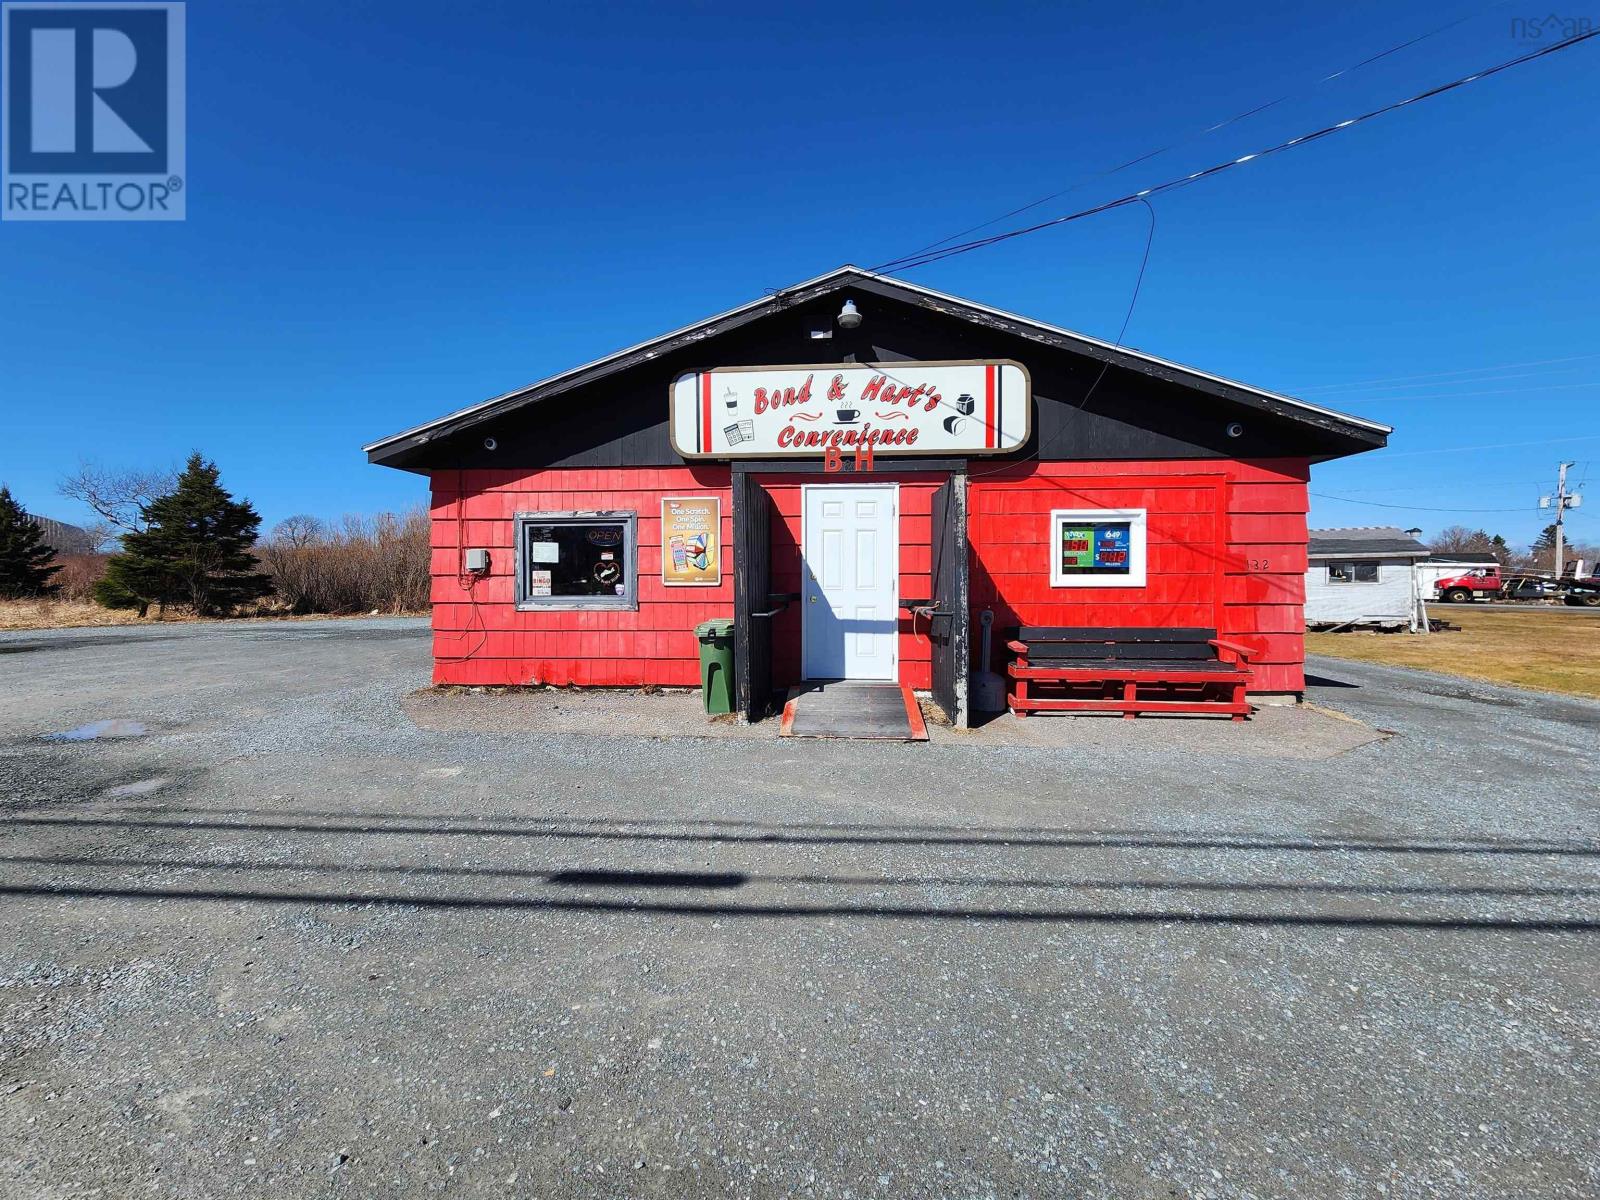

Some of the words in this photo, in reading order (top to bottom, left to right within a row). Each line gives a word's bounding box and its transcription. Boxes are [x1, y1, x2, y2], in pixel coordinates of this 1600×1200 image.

[754, 374, 814, 415] Bond
[826, 373, 850, 401] &
[861, 375, 942, 412] Hart's
[777, 422, 920, 448] Convenience
[825, 446, 843, 472] B
[855, 445, 874, 472] H
[588, 530, 622, 541] OPEN
[1246, 559, 1270, 570] 132
